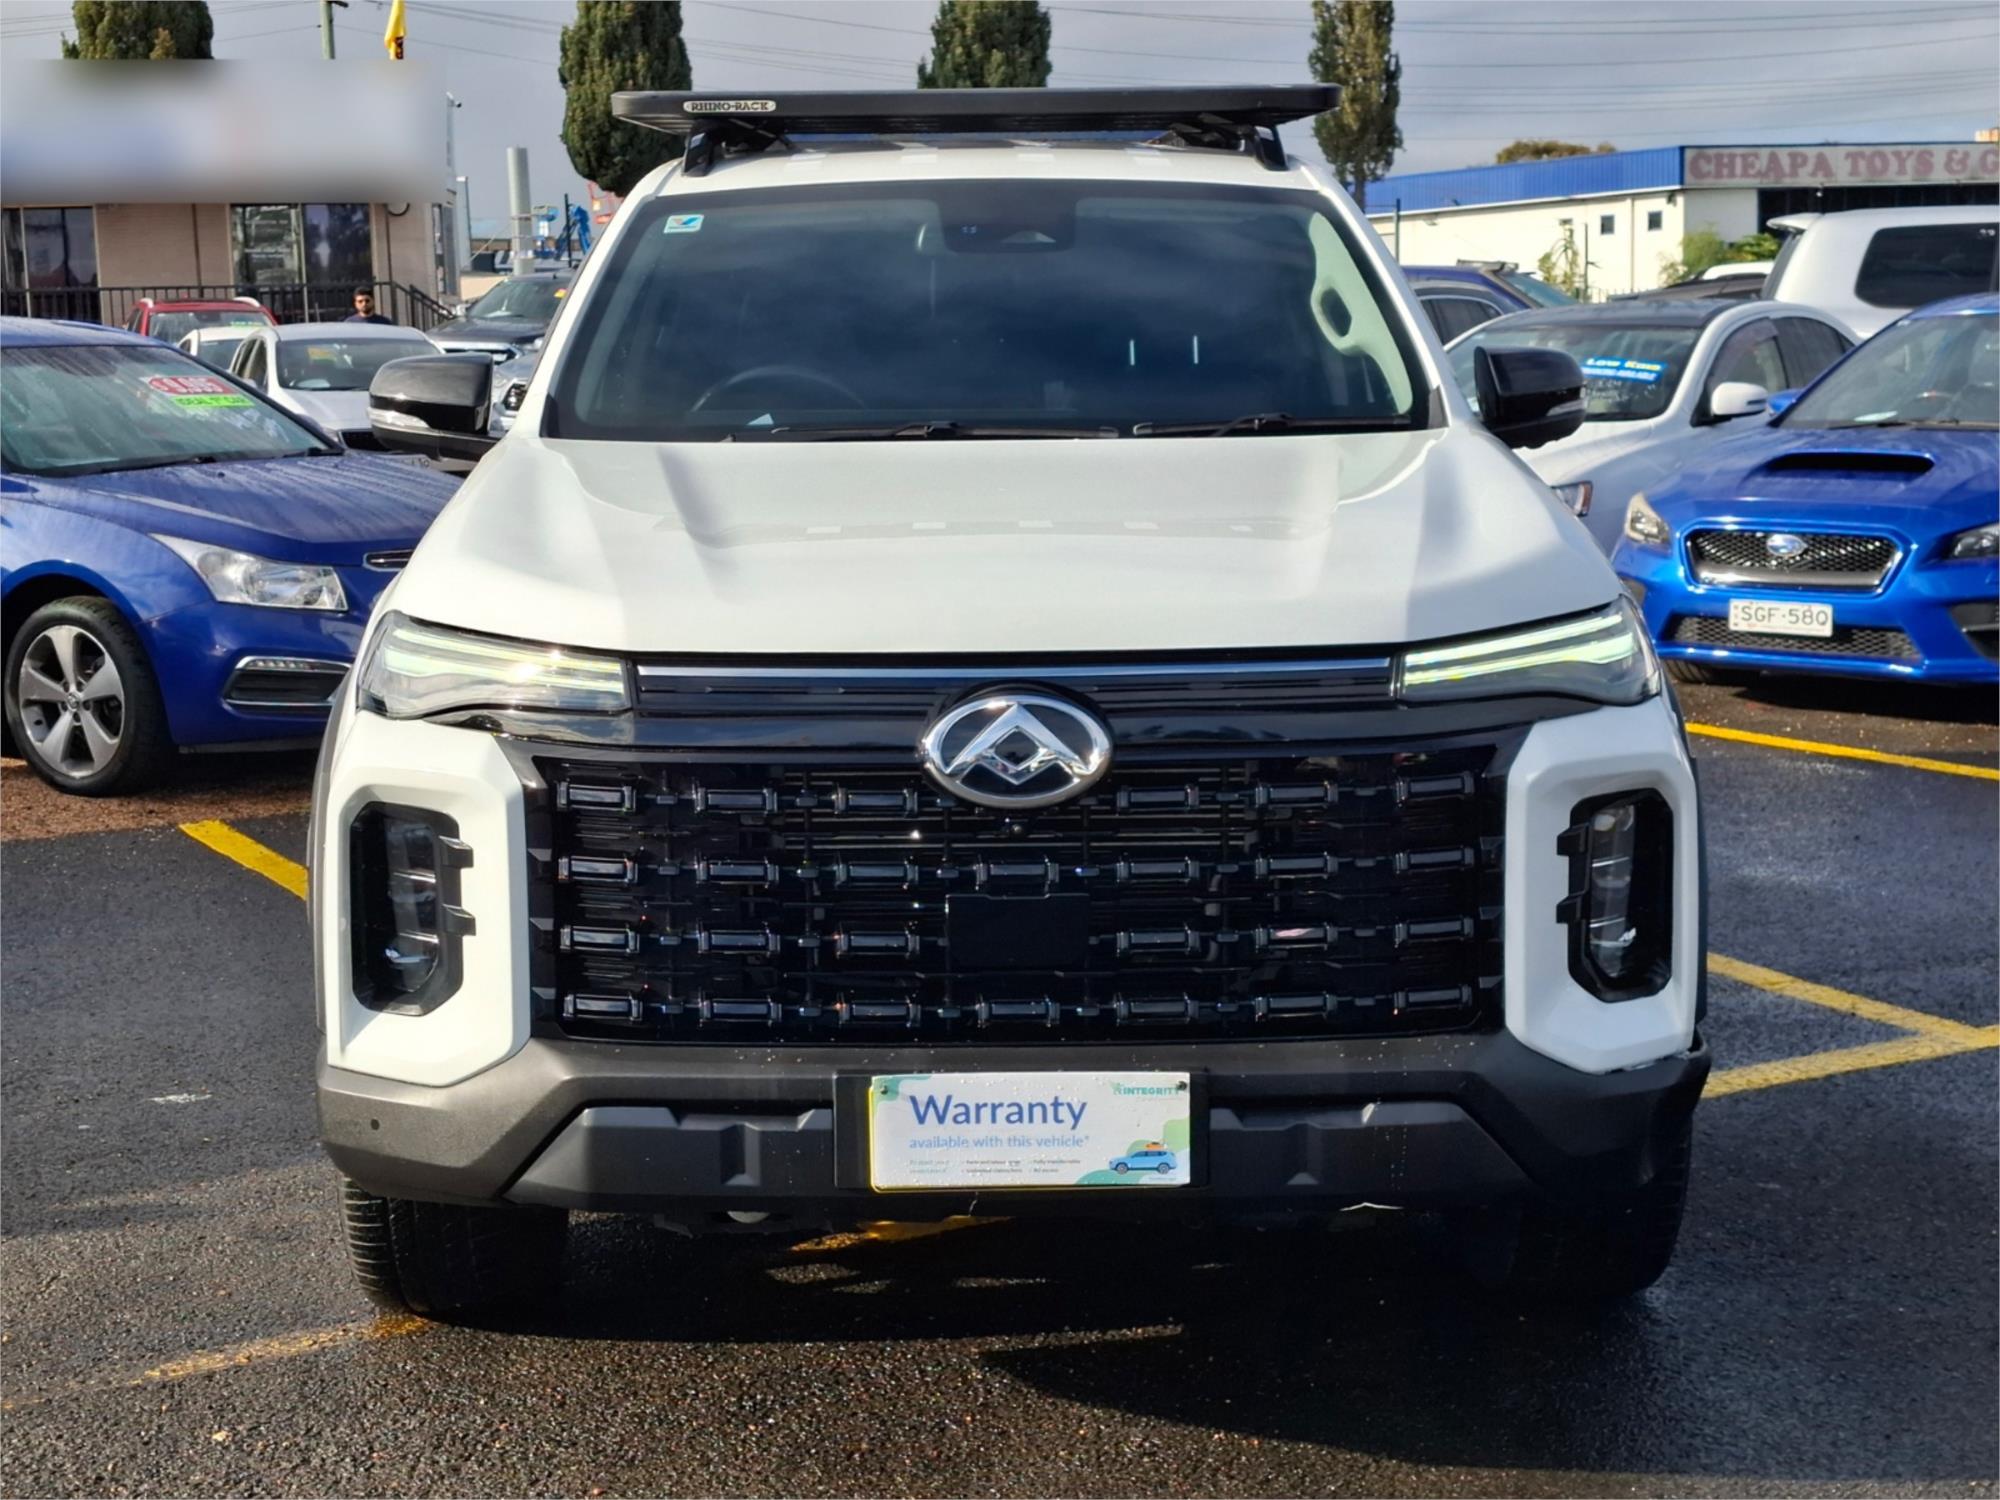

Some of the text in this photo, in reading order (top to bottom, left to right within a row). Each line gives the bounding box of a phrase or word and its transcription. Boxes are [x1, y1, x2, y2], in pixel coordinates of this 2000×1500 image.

[691, 101, 769, 111] RHINO-RACK
[1689, 150, 1834, 179] CHEAPA
[1844, 150, 1935, 177] TOYS
[1944, 149, 1971, 175] &
[909, 1094, 1087, 1129] Warranty
[909, 1135, 969, 1149] available
[973, 1134, 1004, 1148] with
[1008, 1134, 1032, 1148] this
